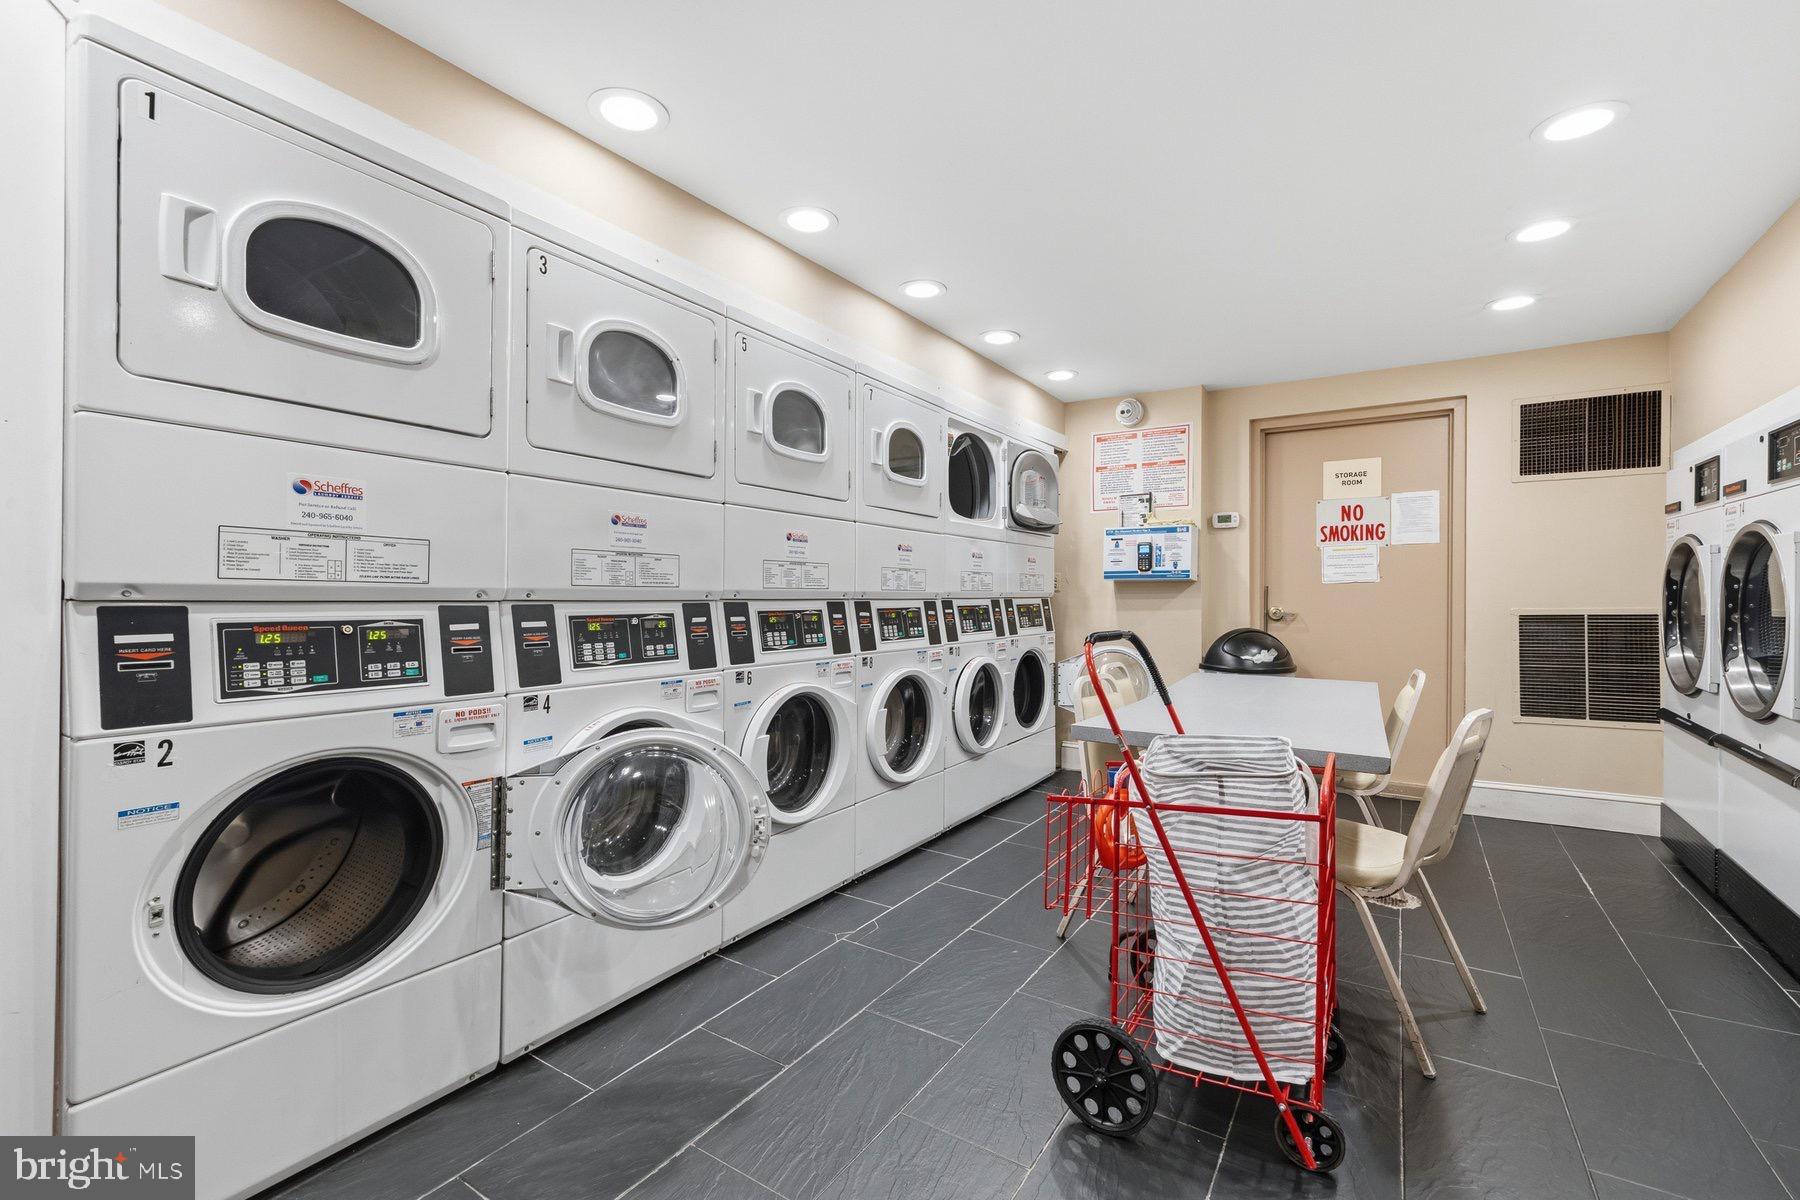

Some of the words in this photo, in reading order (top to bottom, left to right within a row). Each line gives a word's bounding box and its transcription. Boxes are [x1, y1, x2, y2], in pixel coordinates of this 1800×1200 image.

[144, 91, 156, 120] 1
[539, 256, 548, 274] 3
[742, 337, 747, 352] 5
[868, 388, 874, 400] 7
[314, 480, 363, 495] Scheffres
[302, 511, 354, 521] 240-965-6040
[1340, 504, 1364, 522] NO
[1320, 523, 1385, 542] SMOKING
[747, 671, 752, 685] 6
[543, 694, 551, 714] 4
[157, 739, 173, 767] 2
[127, 804, 171, 815] NOTICE
